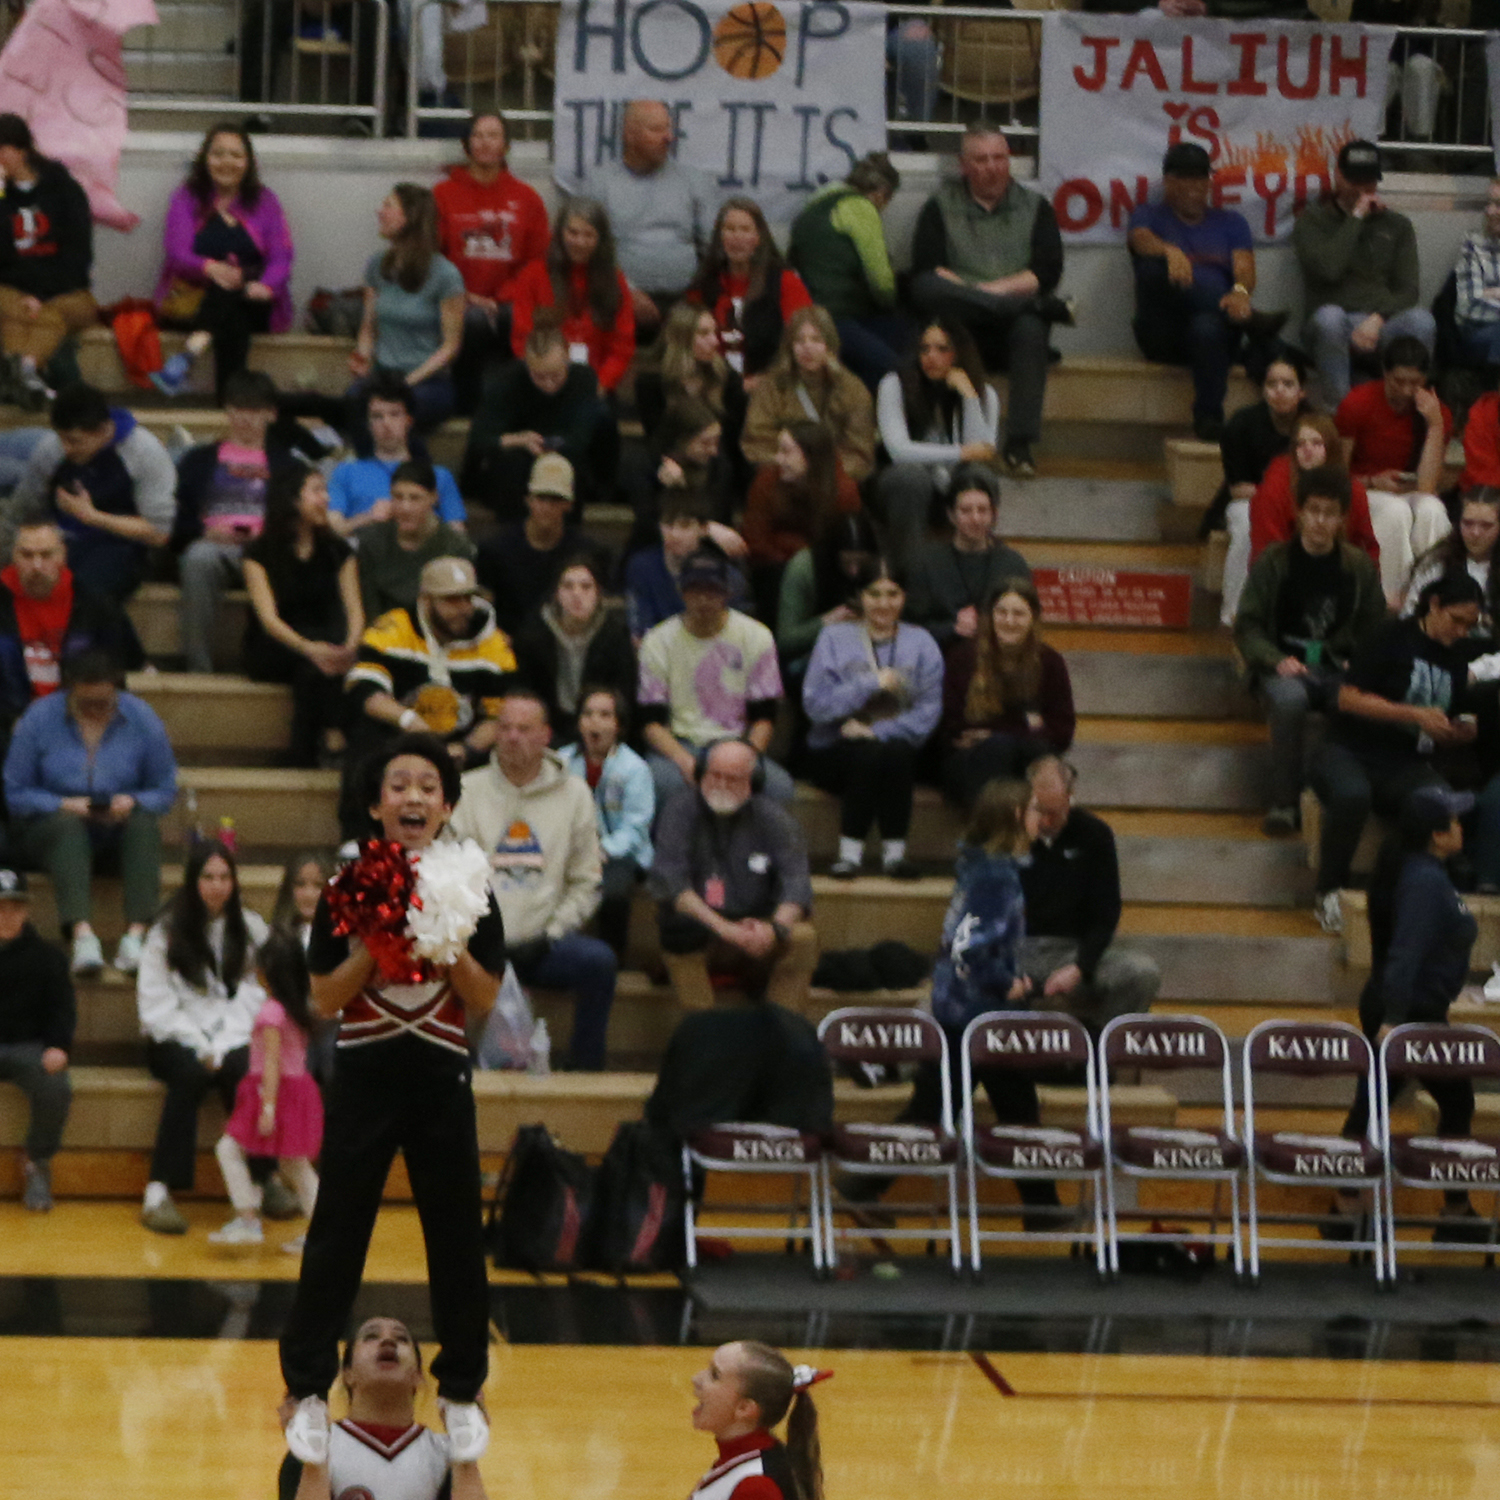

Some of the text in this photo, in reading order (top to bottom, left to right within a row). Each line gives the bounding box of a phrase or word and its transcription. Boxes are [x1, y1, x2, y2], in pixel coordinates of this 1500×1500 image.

[1073, 34, 1369, 99] JALIUH
[717, 101, 778, 188] IT
[841, 1022, 923, 1048] KAYHI
[986, 1028, 1071, 1053] KAYHI
[1125, 1031, 1207, 1056] KAYHI
[1268, 1035, 1350, 1061] KAYHI
[1404, 1040, 1486, 1065] KAYHI
[733, 1140, 806, 1162] KINGS
[869, 1141, 942, 1163] KINGS
[1013, 1146, 1085, 1169] KINGS
[1153, 1148, 1225, 1169] KINGS
[1294, 1154, 1366, 1176] KINGS
[1430, 1162, 1500, 1183] KINGS
